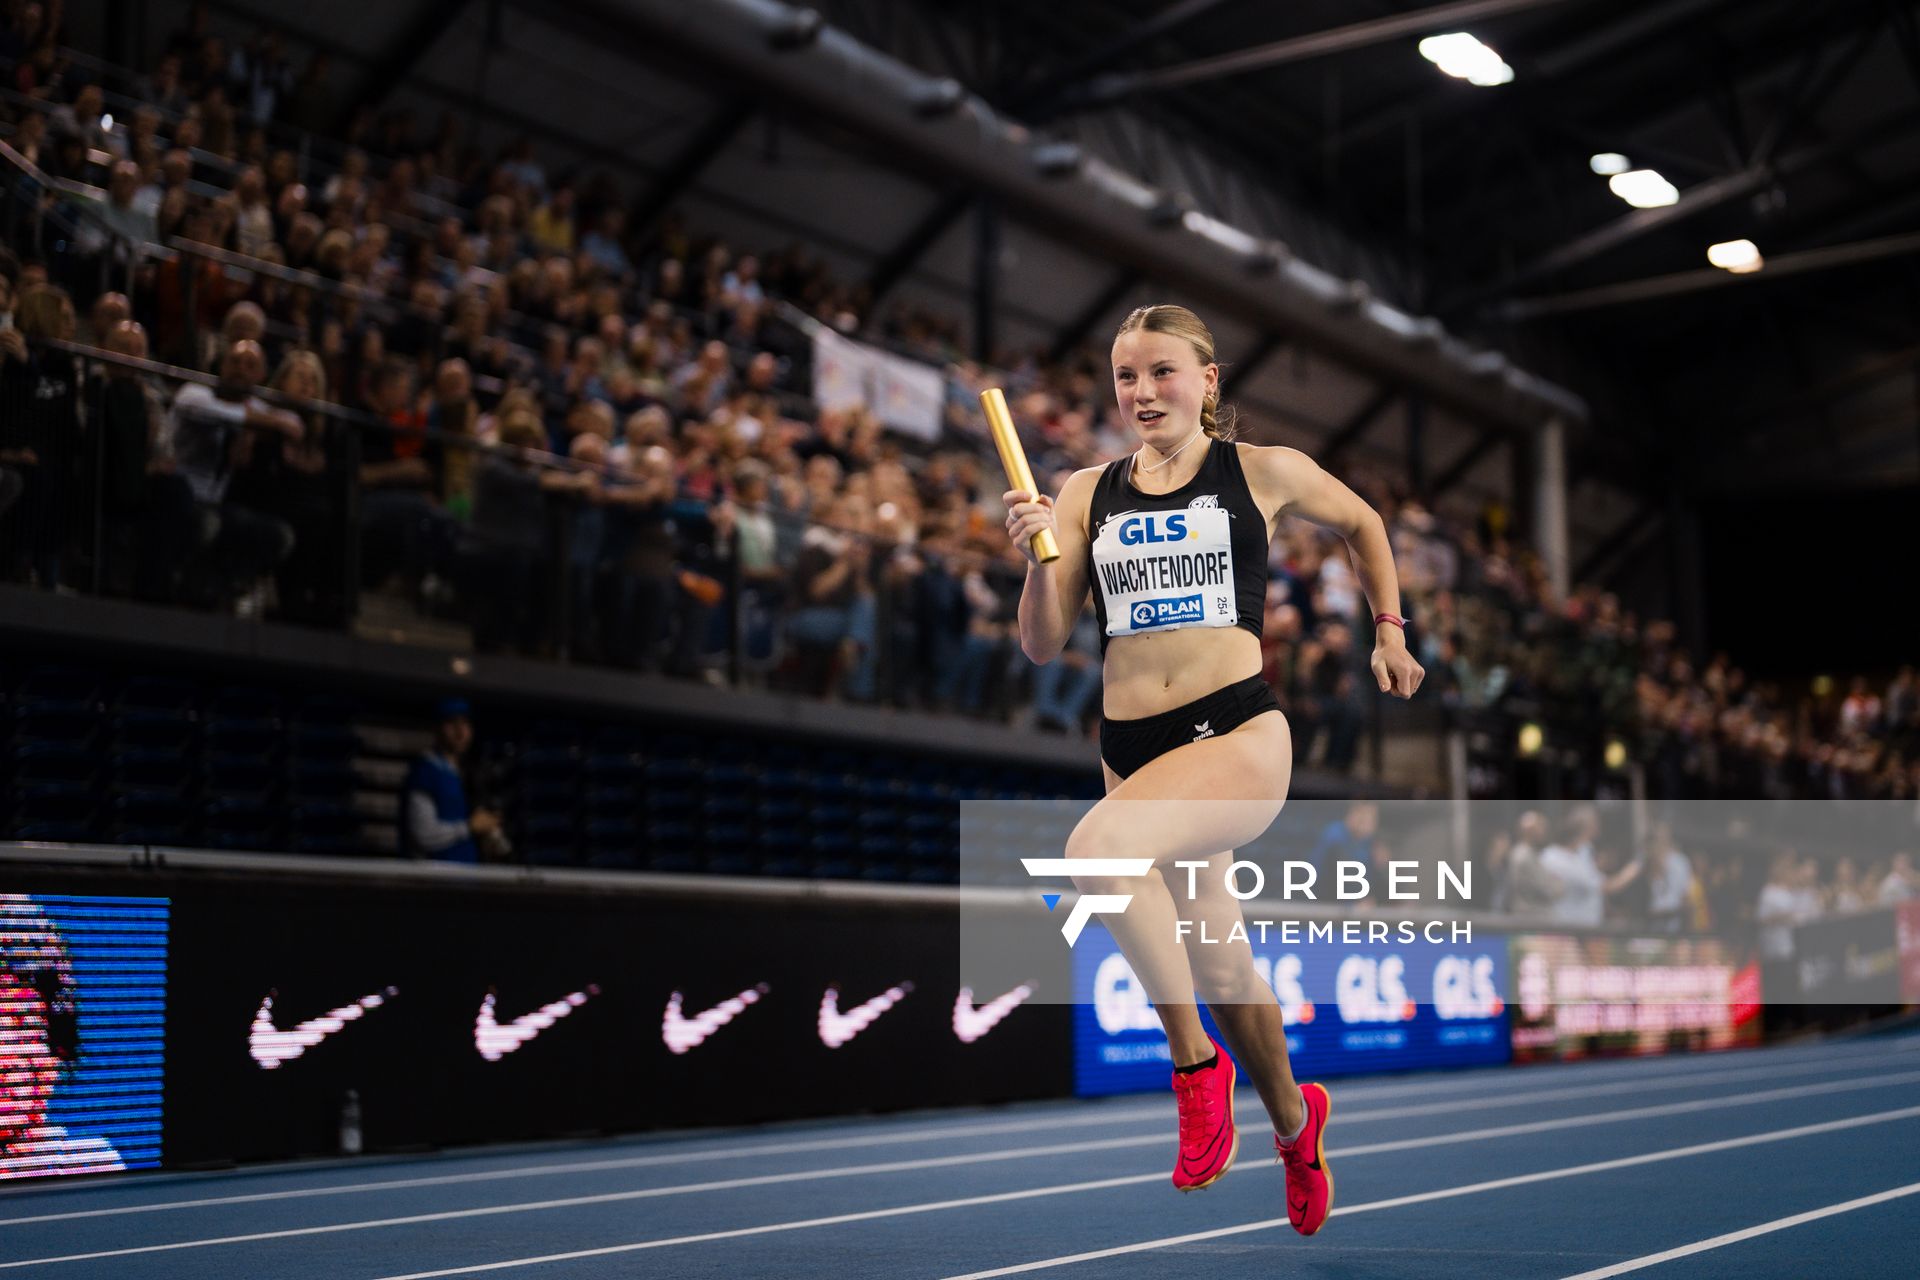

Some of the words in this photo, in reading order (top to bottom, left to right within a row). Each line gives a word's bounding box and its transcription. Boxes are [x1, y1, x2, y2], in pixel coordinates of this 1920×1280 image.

[1101, 551, 1228, 595] WACHTENDORF
[1158, 600, 1200, 615] PLAN
[1217, 597, 1228, 615] 254
[1159, 613, 1201, 622] INTERNATIONAL
